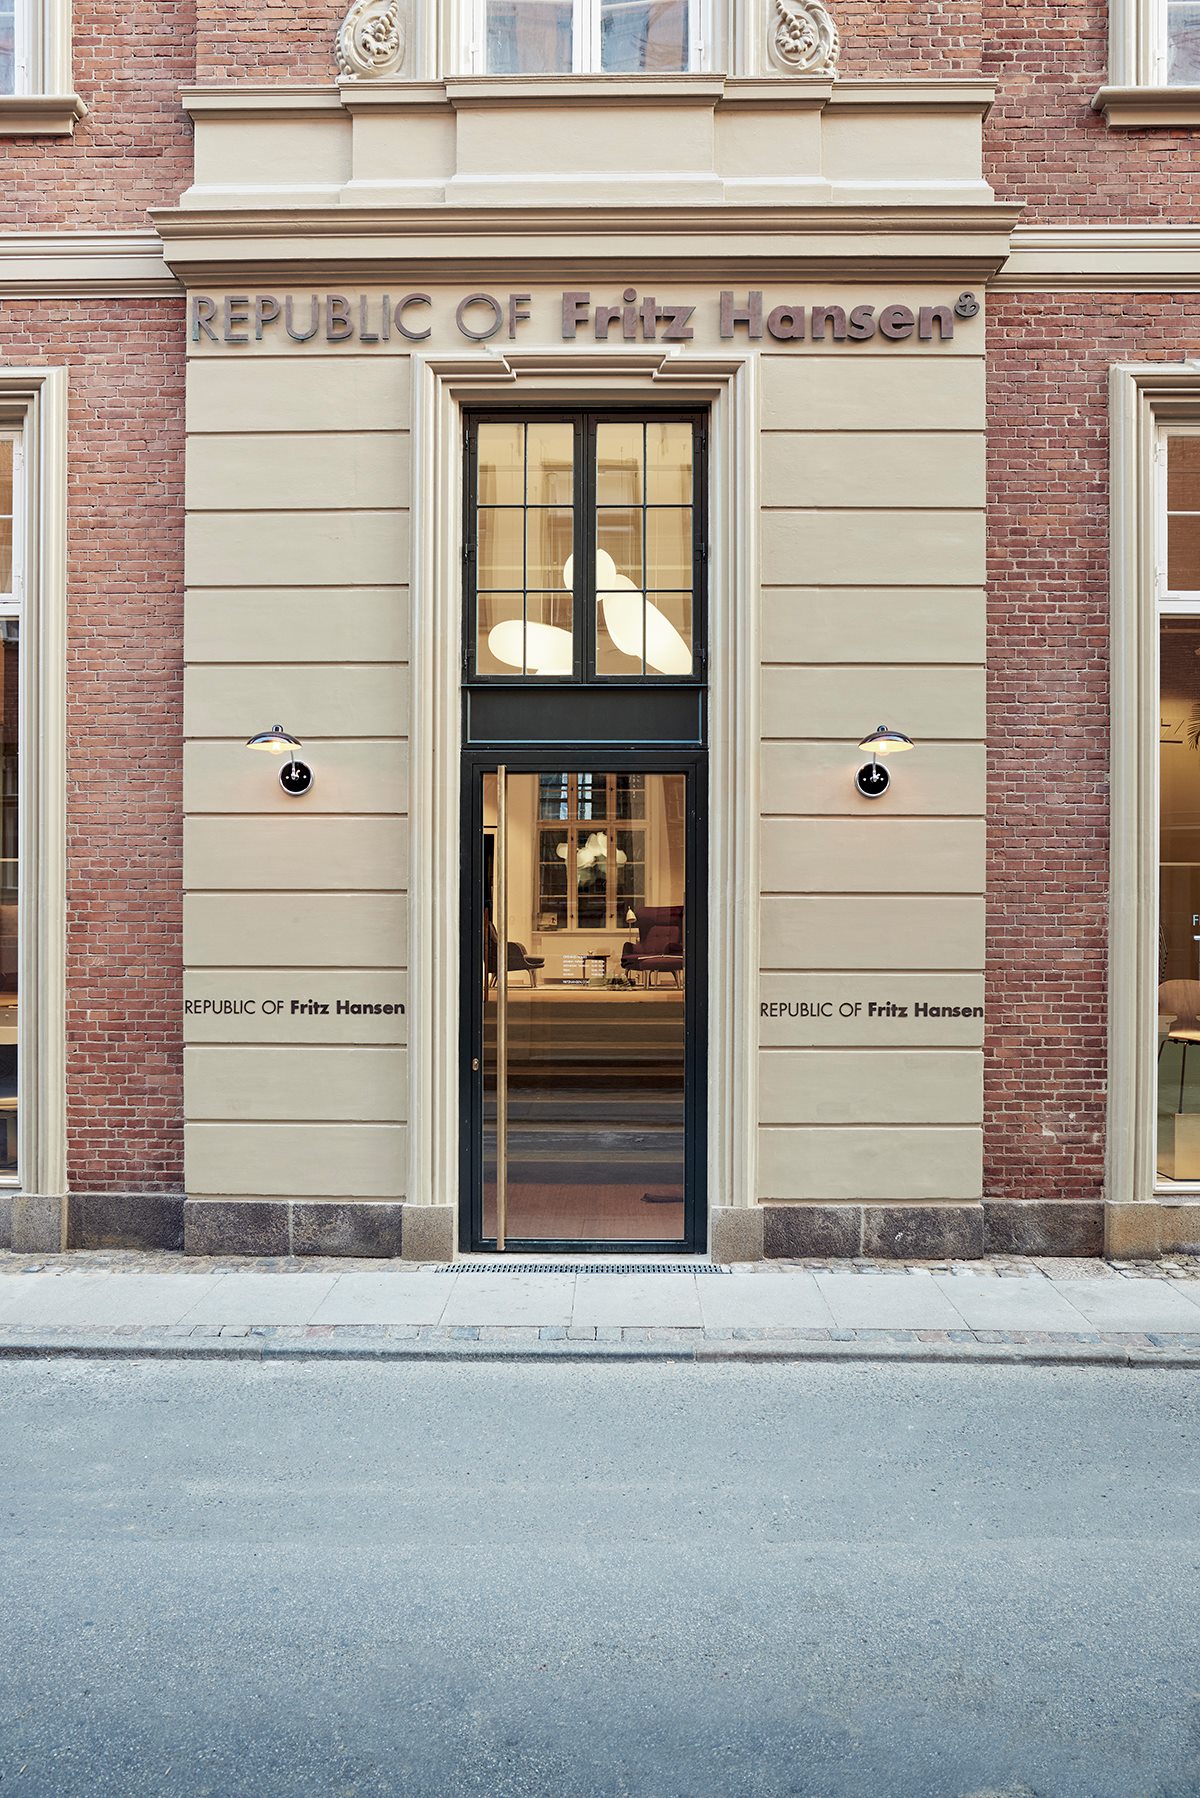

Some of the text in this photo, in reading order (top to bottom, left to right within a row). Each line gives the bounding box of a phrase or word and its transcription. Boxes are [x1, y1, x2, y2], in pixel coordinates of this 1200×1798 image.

[192, 288, 954, 341] REPUBLIC OF Fritz Hansen
[185, 999, 405, 1015] REPUBLIC OF Fritz Hansen
[760, 1001, 984, 1018] REPUBLIC OF Fritz Hansen
